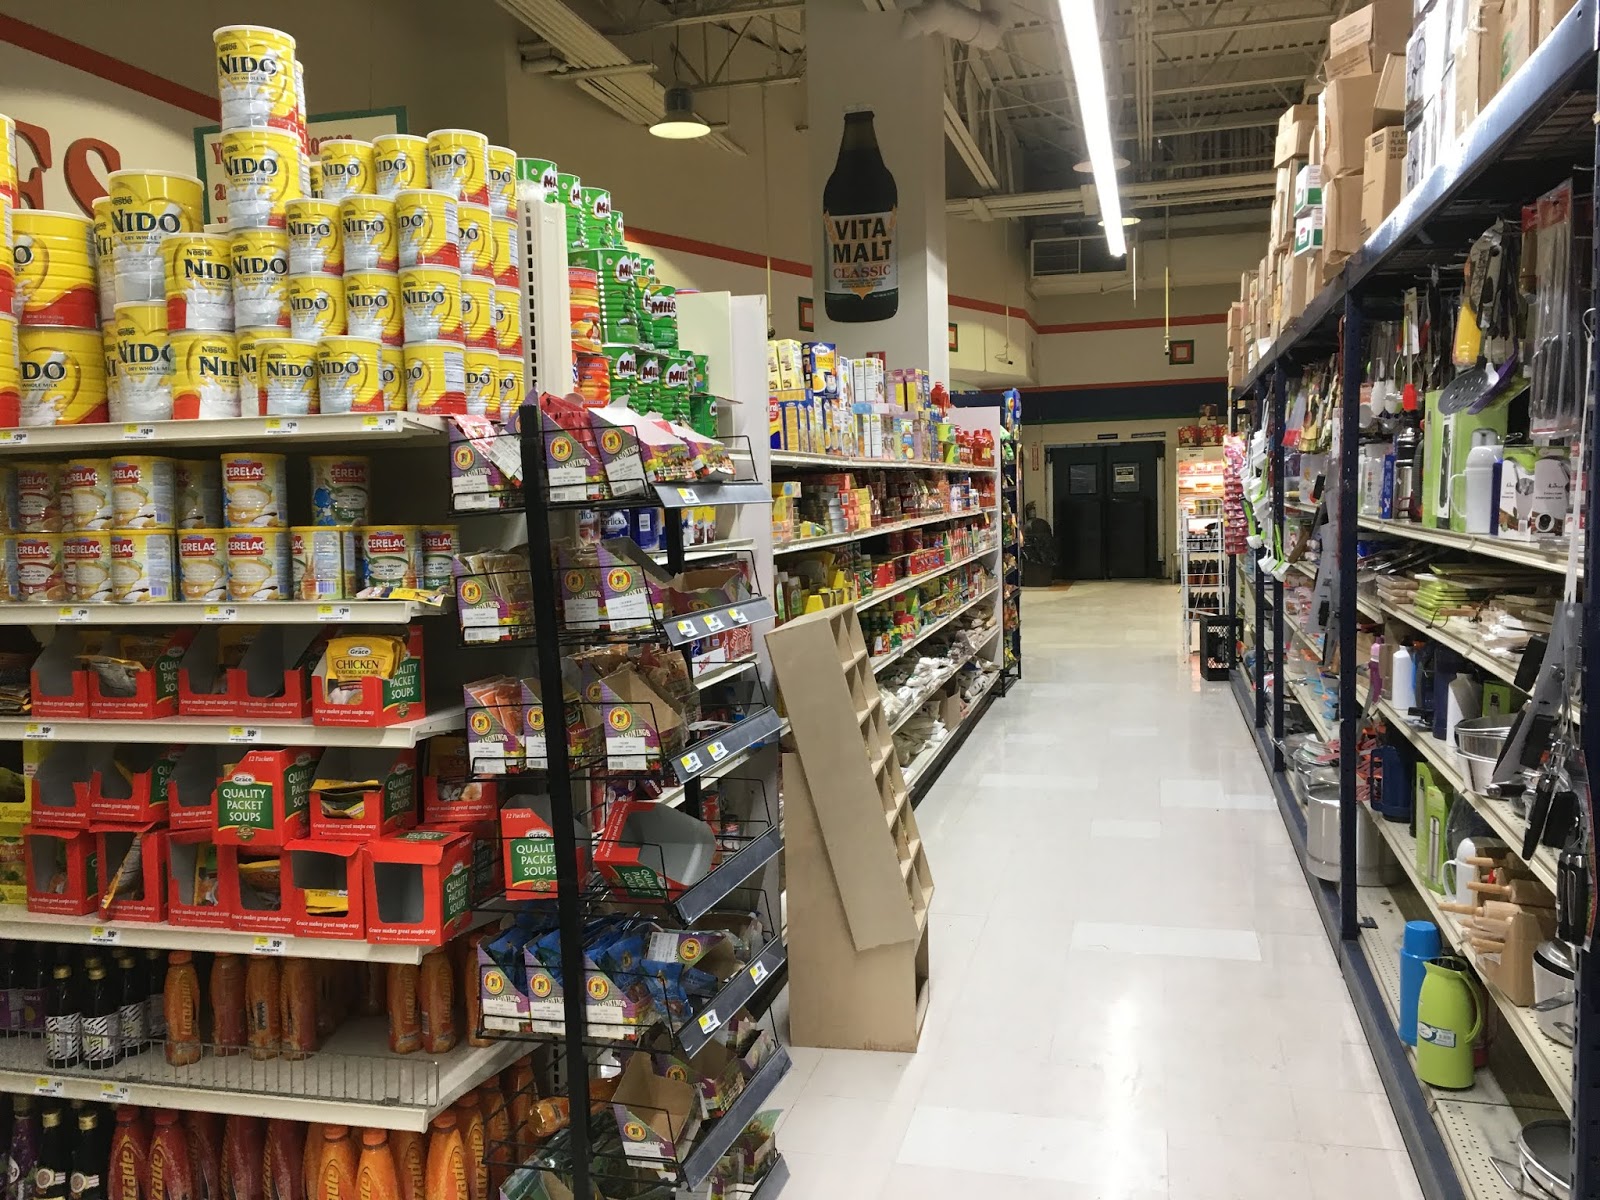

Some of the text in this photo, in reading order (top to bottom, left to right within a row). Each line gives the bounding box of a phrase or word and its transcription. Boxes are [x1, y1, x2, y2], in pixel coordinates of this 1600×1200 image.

[218, 54, 277, 76] NIDO
[224, 156, 278, 176] NIDO
[377, 159, 406, 172] IDO
[111, 208, 181, 233] NIDO
[342, 218, 384, 233] NIDO
[288, 222, 330, 235] NIDO
[835, 217, 887, 241] VITA
[833, 240, 892, 264] MALT
[184, 258, 231, 280] NID
[233, 255, 287, 275] NIDO
[833, 264, 891, 279] CLASSIC
[290, 296, 328, 311] NIDO
[347, 293, 388, 308] NIDO
[402, 289, 445, 305] NIDO
[22, 361, 66, 380] DO
[267, 361, 314, 378] NIDO
[226, 466, 265, 477] CERELAC
[368, 538, 407, 548] CERELAC
[336, 660, 379, 669] CHICKEN
[389, 675, 416, 688] PACKET
[391, 687, 414, 699] SOUPS
[235, 775, 252, 783] Grace
[222, 788, 266, 799] QUALITY
[226, 800, 263, 811] PACKET
[229, 811, 261, 822] SOUPS
[516, 845, 554, 854] QUALIT
[446, 872, 468, 893] QUALITY
[448, 887, 467, 903] PACKET
[450, 899, 466, 914] SOUPS
